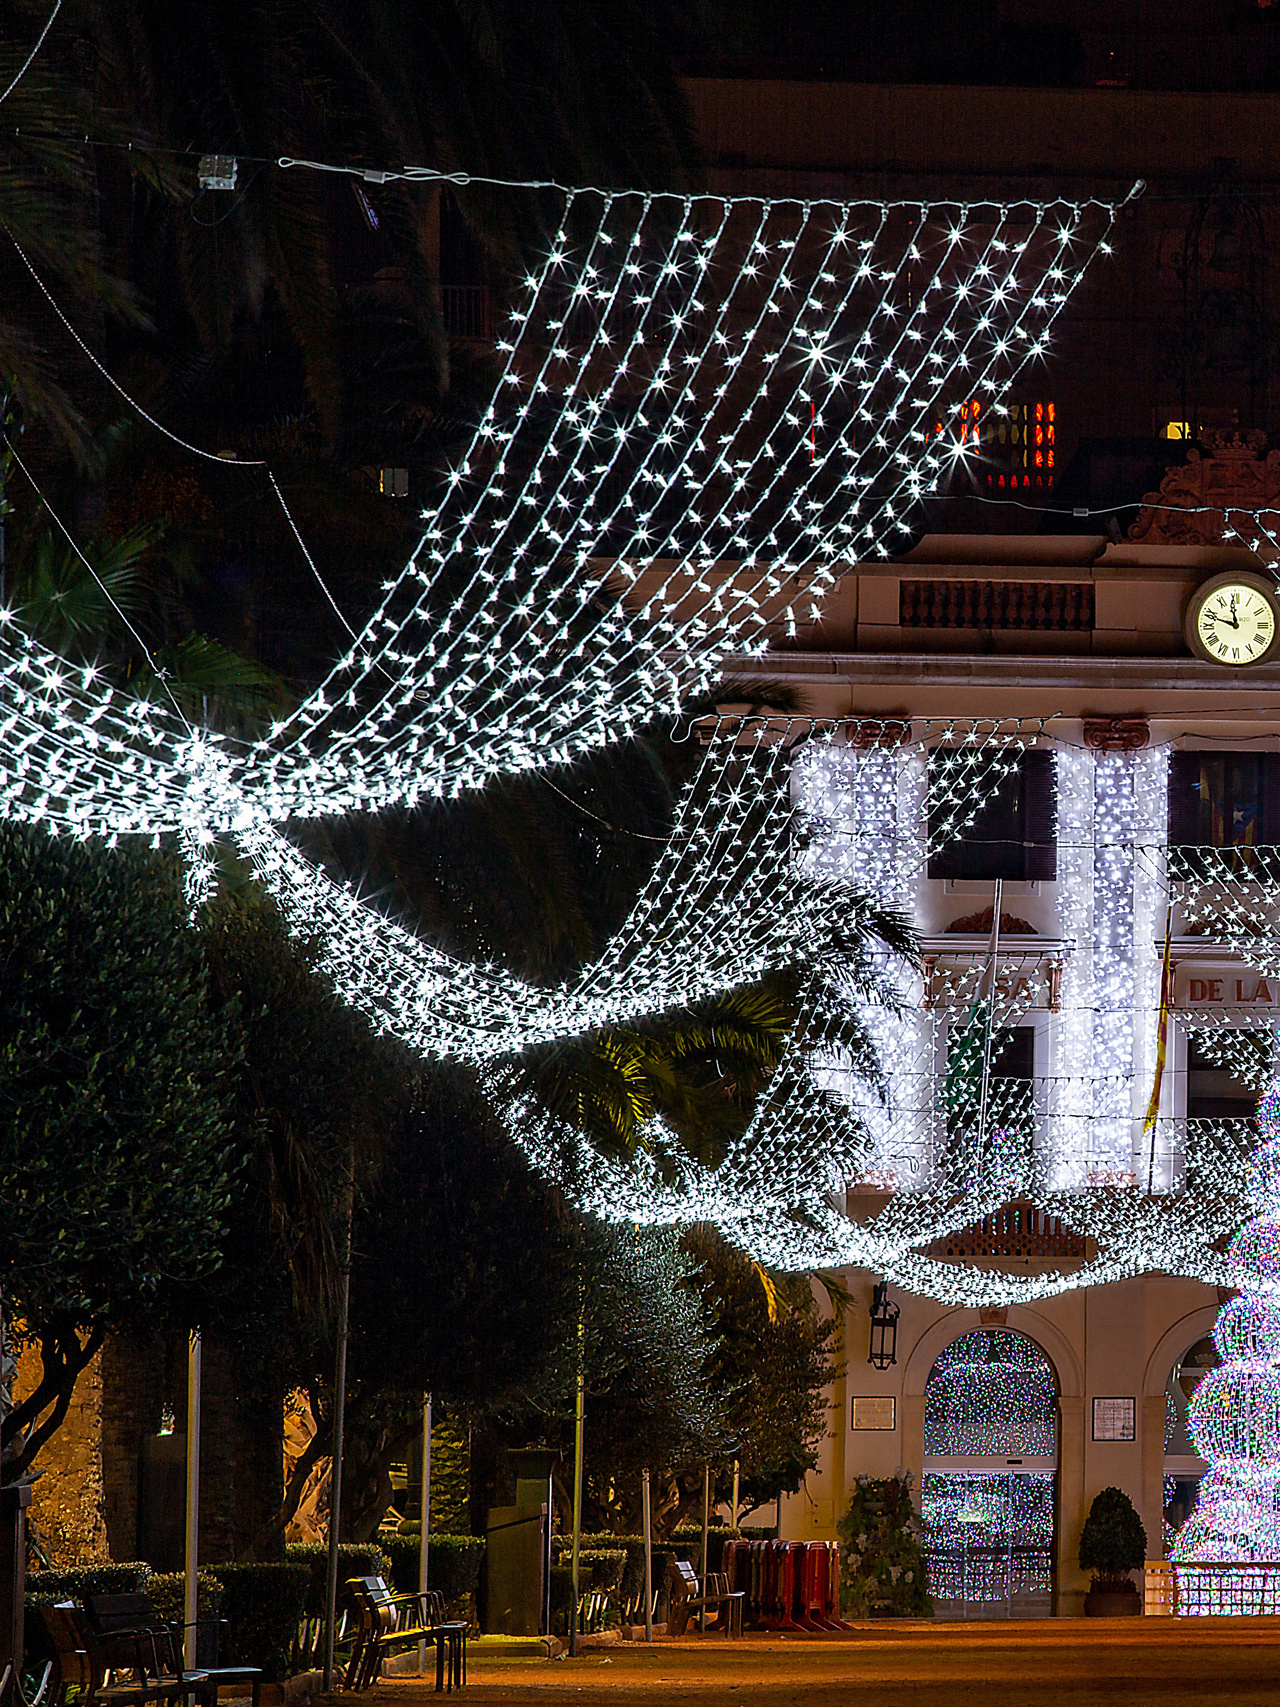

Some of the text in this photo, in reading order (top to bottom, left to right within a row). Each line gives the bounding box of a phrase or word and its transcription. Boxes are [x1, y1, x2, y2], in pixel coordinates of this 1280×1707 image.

[1253, 607, 1265, 617] II
[1203, 622, 1215, 630] IX
[1231, 647, 1240, 659] VI
[1245, 643, 1254, 655] V
[951, 977, 1035, 1001] CSA
[1189, 979, 1273, 1002] DE LA
